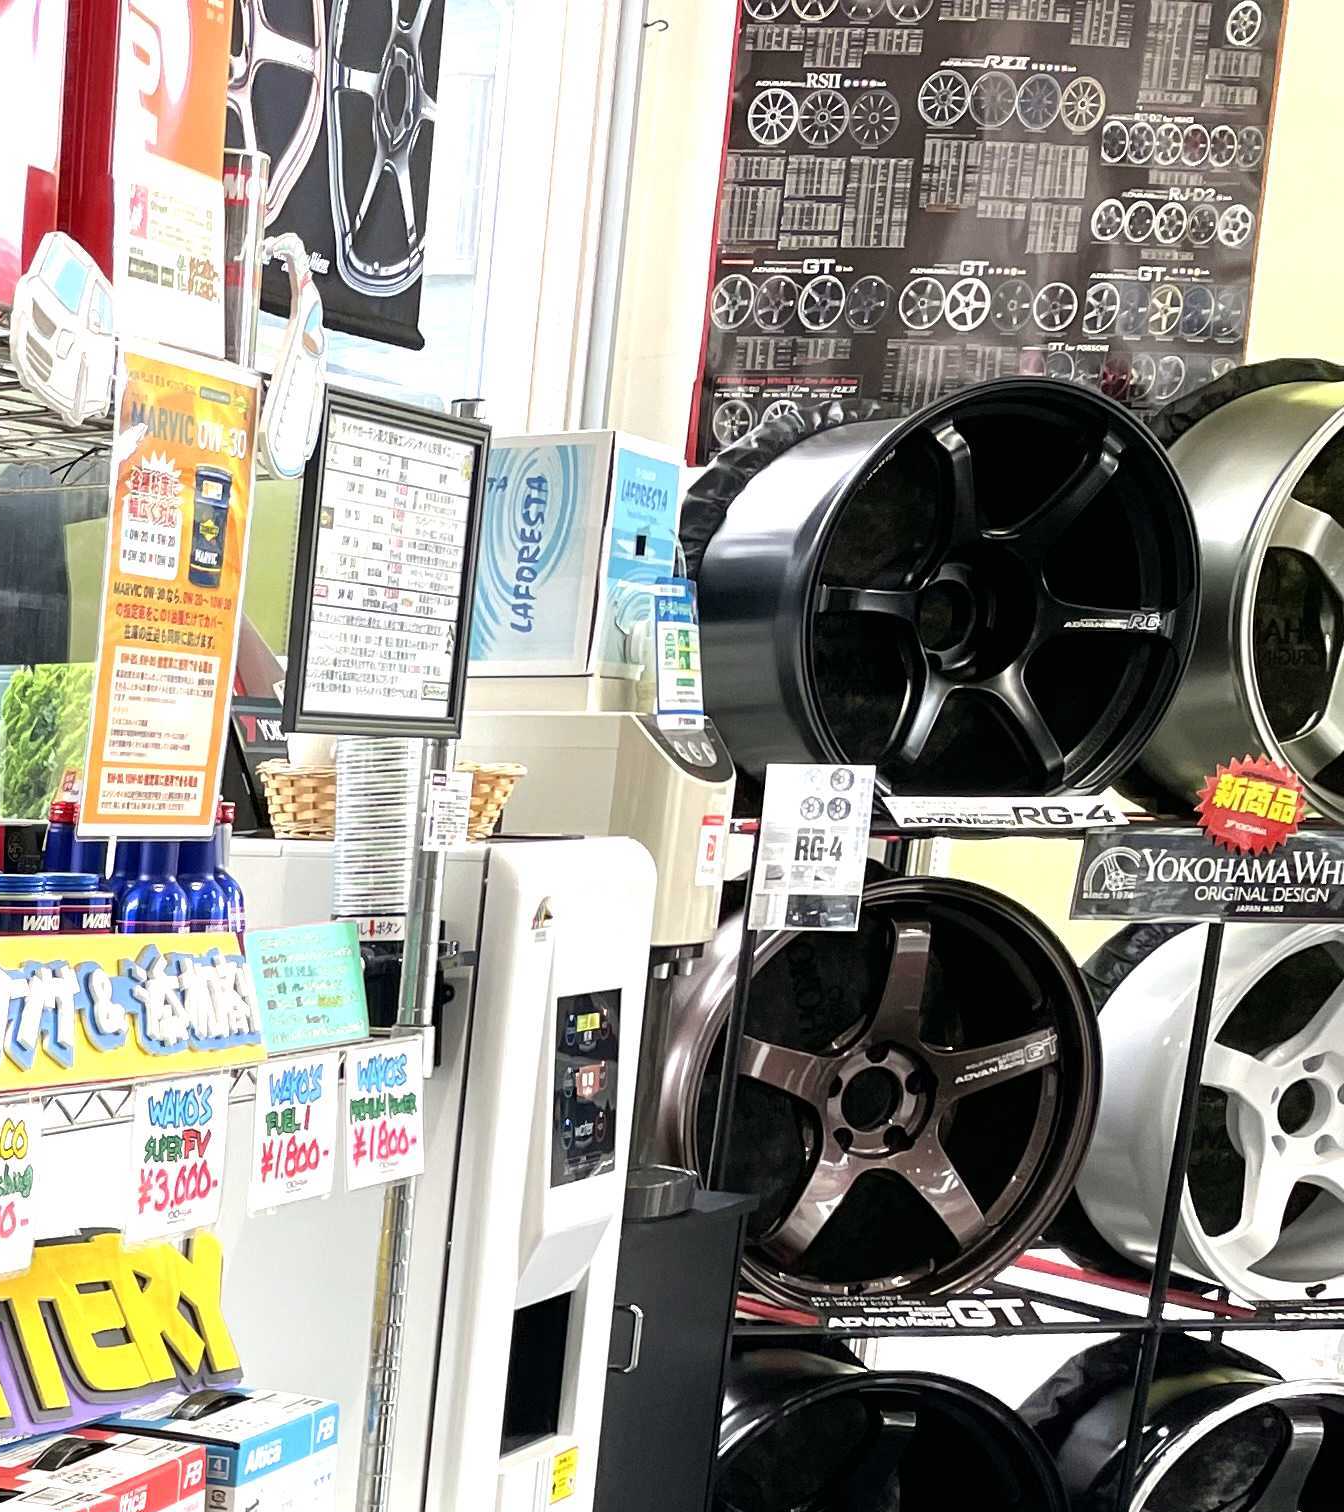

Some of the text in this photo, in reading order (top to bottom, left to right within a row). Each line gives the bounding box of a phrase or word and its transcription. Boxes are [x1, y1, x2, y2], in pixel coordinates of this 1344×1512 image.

[510, 475, 550, 634] LAFORESTA
[1213, 774, 1300, 825] 新商品
[904, 815, 973, 826] ADVAN
[1015, 804, 1115, 826] RG-4
[796, 836, 843, 862] RG-4
[1141, 849, 1291, 883] YOKOHAMA
[1195, 886, 1330, 903] ORIGINAL DESIGN
[375, 920, 402, 935] ボタン
[1025, 1033, 1057, 1064] GT
[265, 1106, 301, 1136] FUEL
[182, 1128, 212, 1159] FV
[828, 1316, 906, 1329] ADVAN
[946, 1299, 1026, 1328] GT
